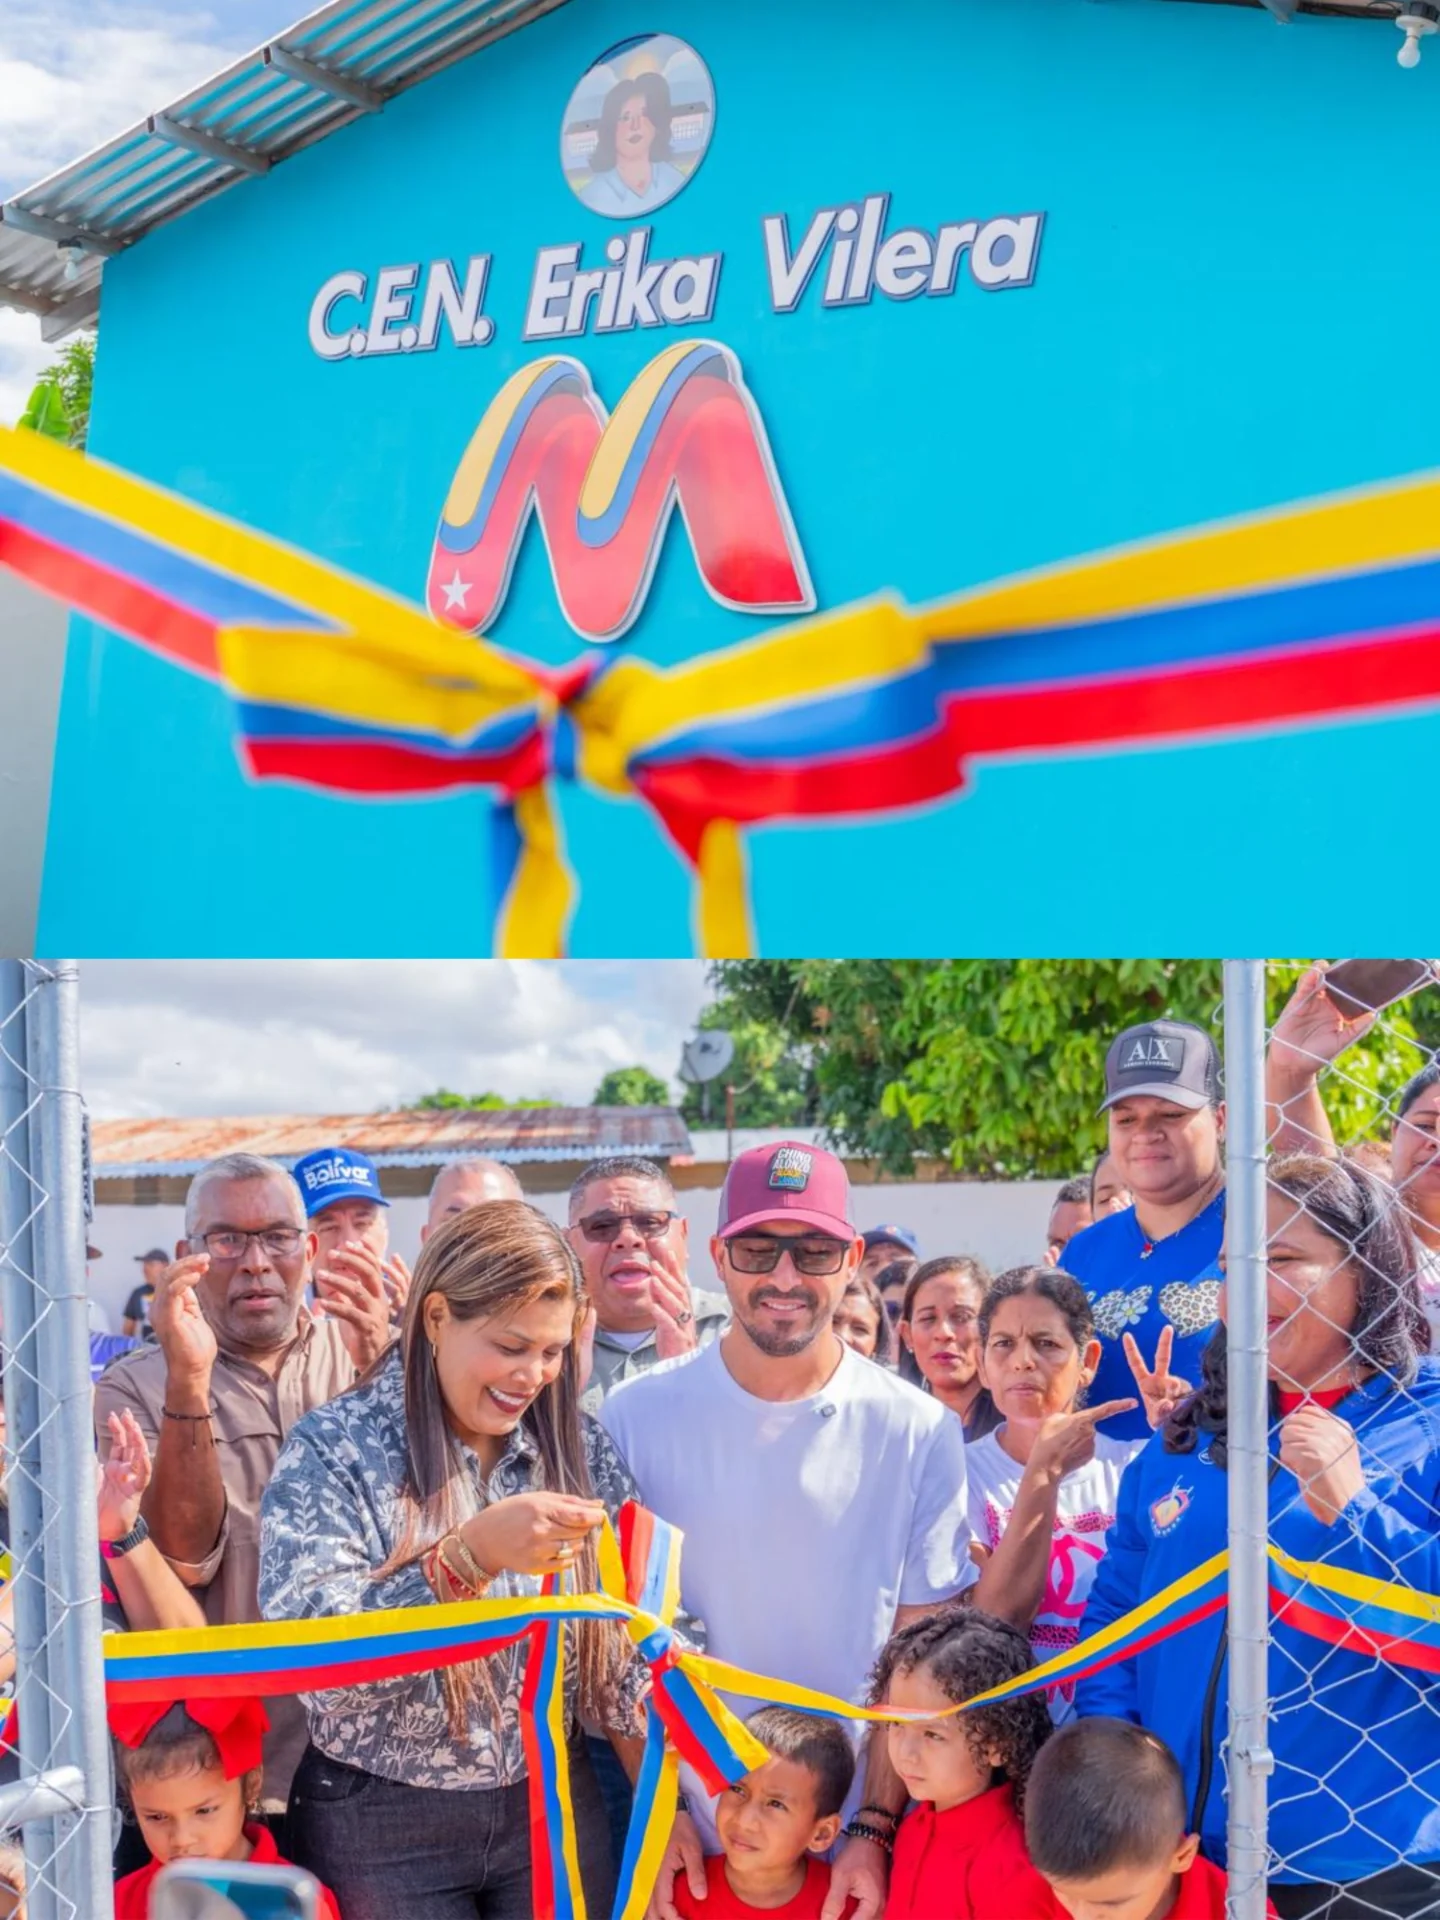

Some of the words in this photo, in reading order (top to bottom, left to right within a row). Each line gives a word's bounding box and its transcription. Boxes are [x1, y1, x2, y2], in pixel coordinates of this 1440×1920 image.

[308, 255, 495, 361] C.E.N.
[523, 227, 722, 339] Erika
[763, 192, 1045, 312] Vilera
